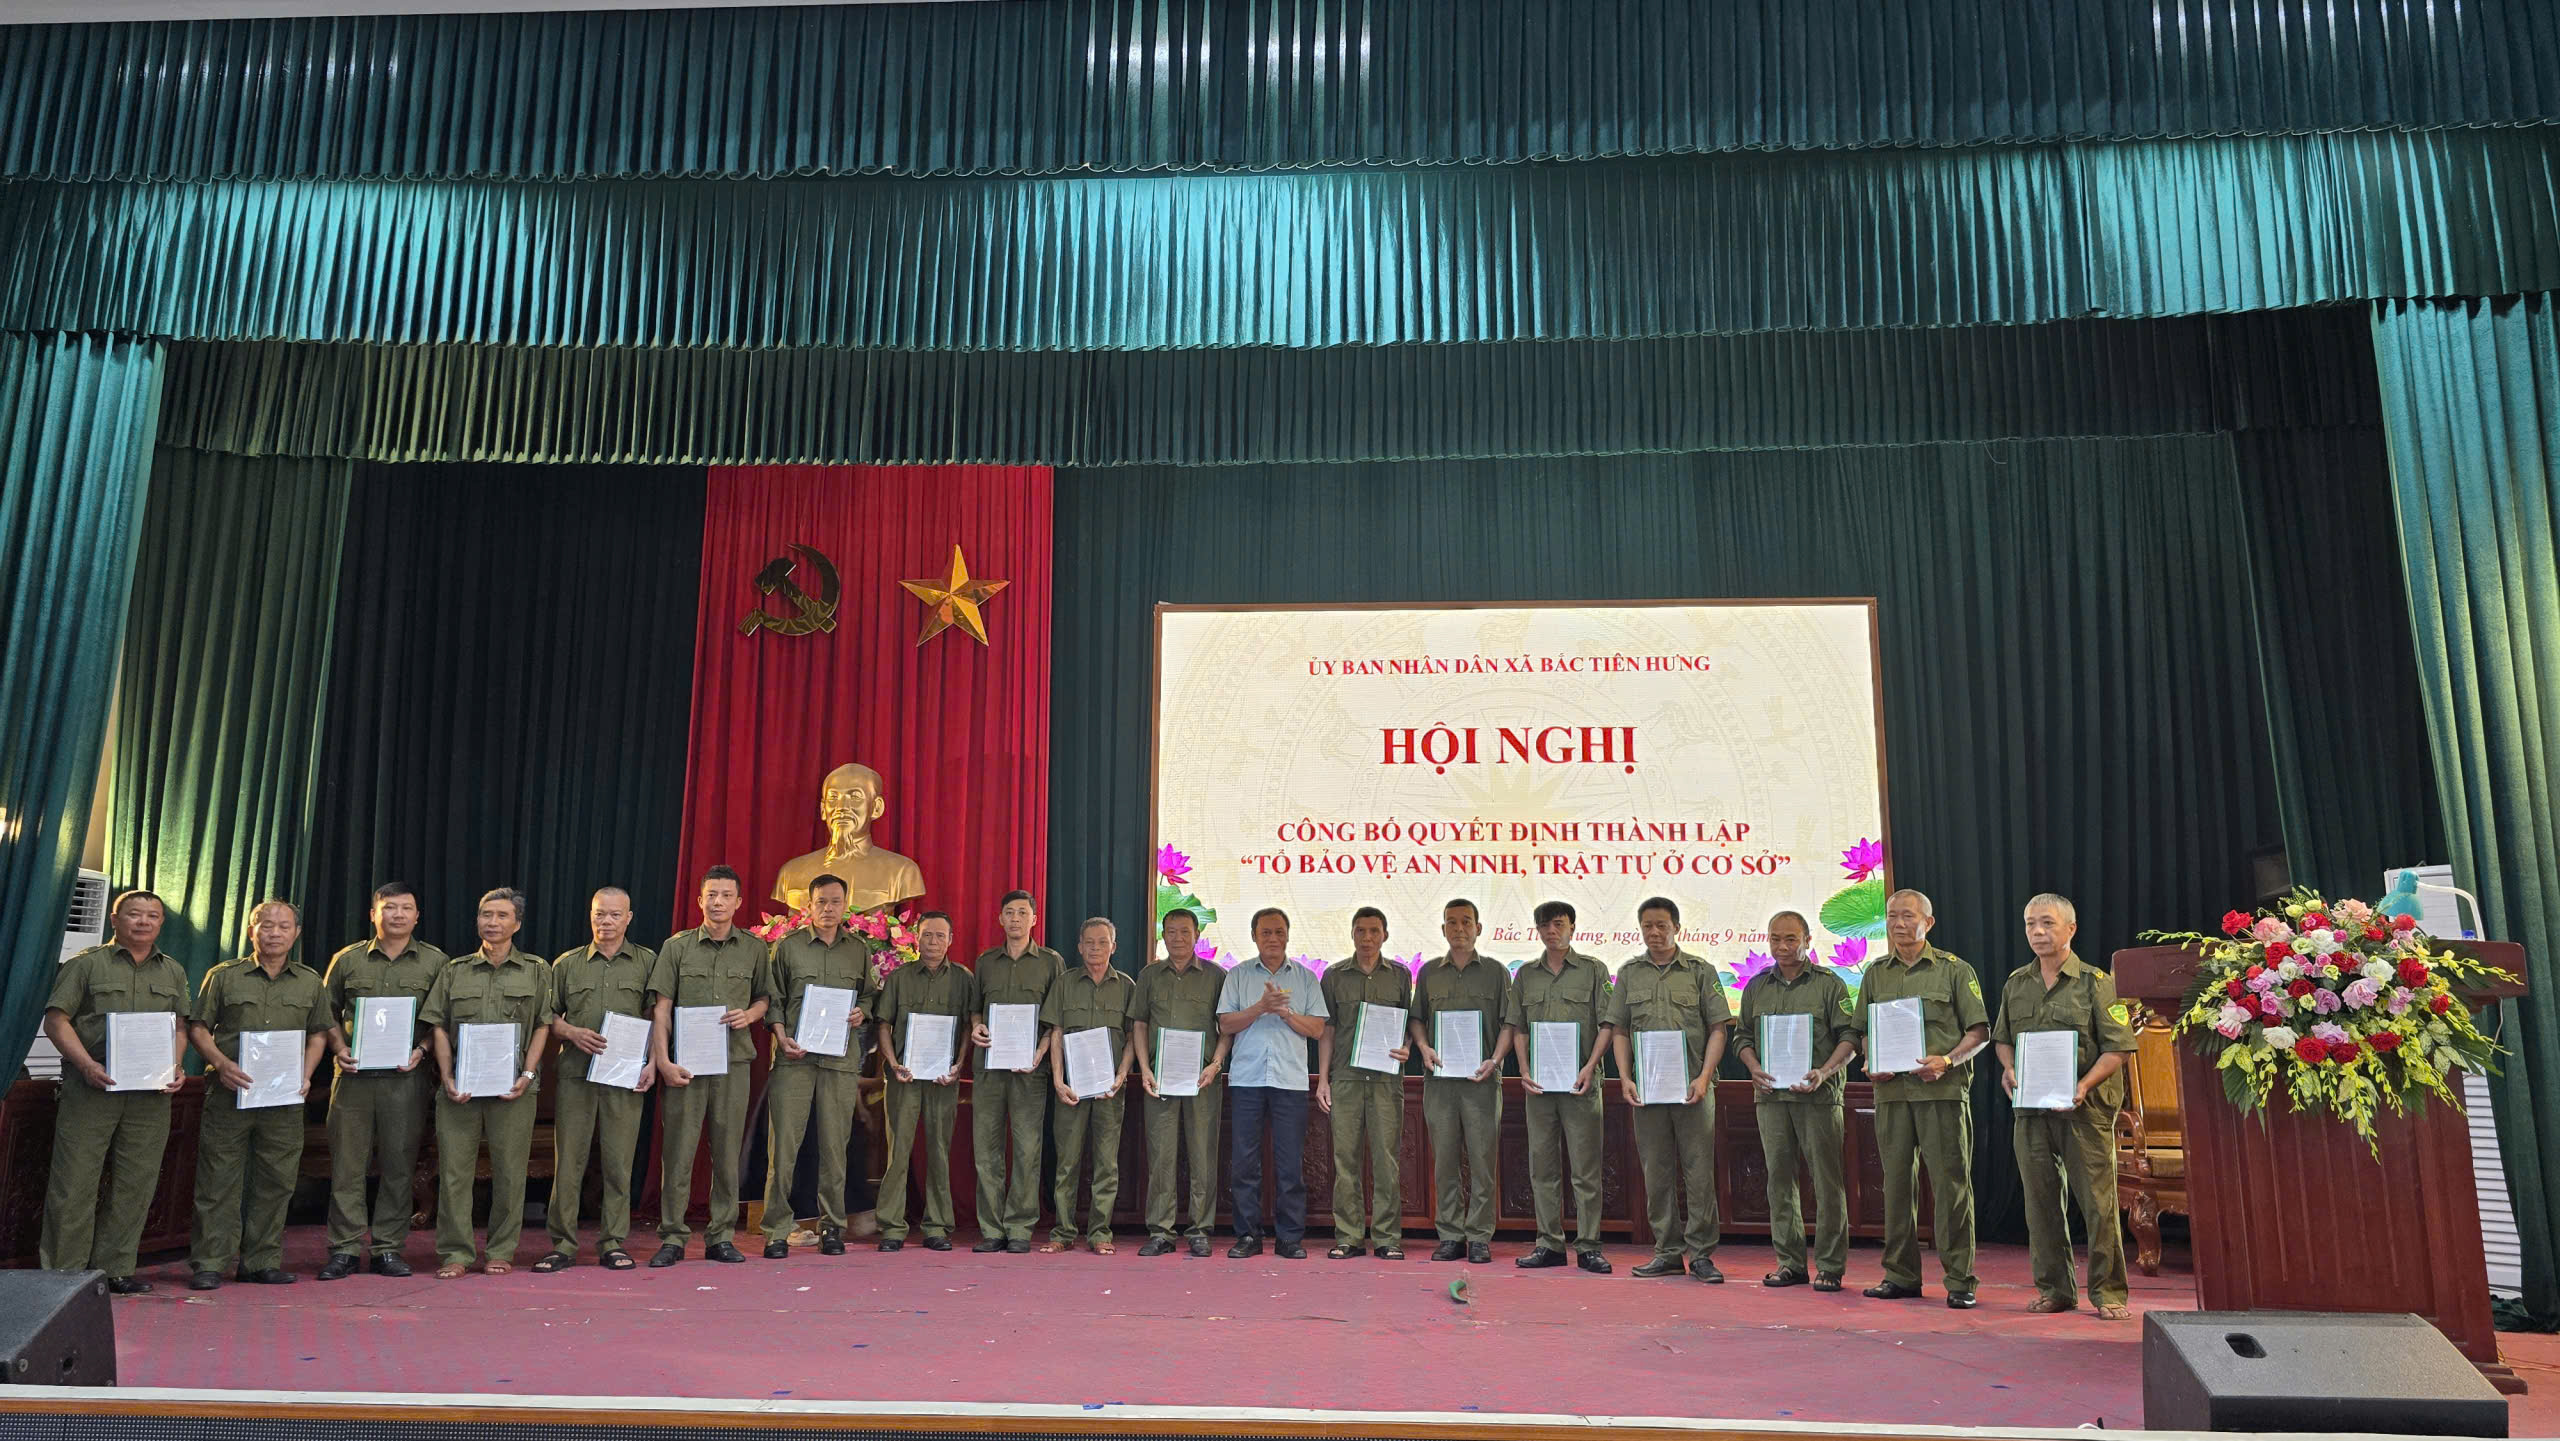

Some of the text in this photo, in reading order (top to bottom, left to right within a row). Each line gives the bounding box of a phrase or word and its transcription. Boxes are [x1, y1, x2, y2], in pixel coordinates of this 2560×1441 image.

[1308, 652, 1710, 676] ỦY BAN NHÂN DÂN XÃ BẮC TIÊN HƯNG
[1379, 721, 1639, 775] HỘI NGHỊ
[1277, 817, 1750, 847] CÔNG BỐ QUYẾT ĐỊNH THÀNH LẬP
[1299, 849, 1355, 874] BẢO
[1362, 852, 1397, 879] VỆ
[1405, 855, 1441, 873] AN
[1449, 855, 1527, 878] NINH,
[1533, 852, 1609, 880] TRẬT
[1616, 852, 1656, 879] TỰ
[1663, 850, 1684, 875] Ở
[1692, 854, 1733, 875] CƠ
[1493, 924, 1521, 941] Bắc
[1569, 931, 1607, 946] ưng,
[1613, 928, 1643, 946] ngà
[1725, 929, 1733, 942] 9
